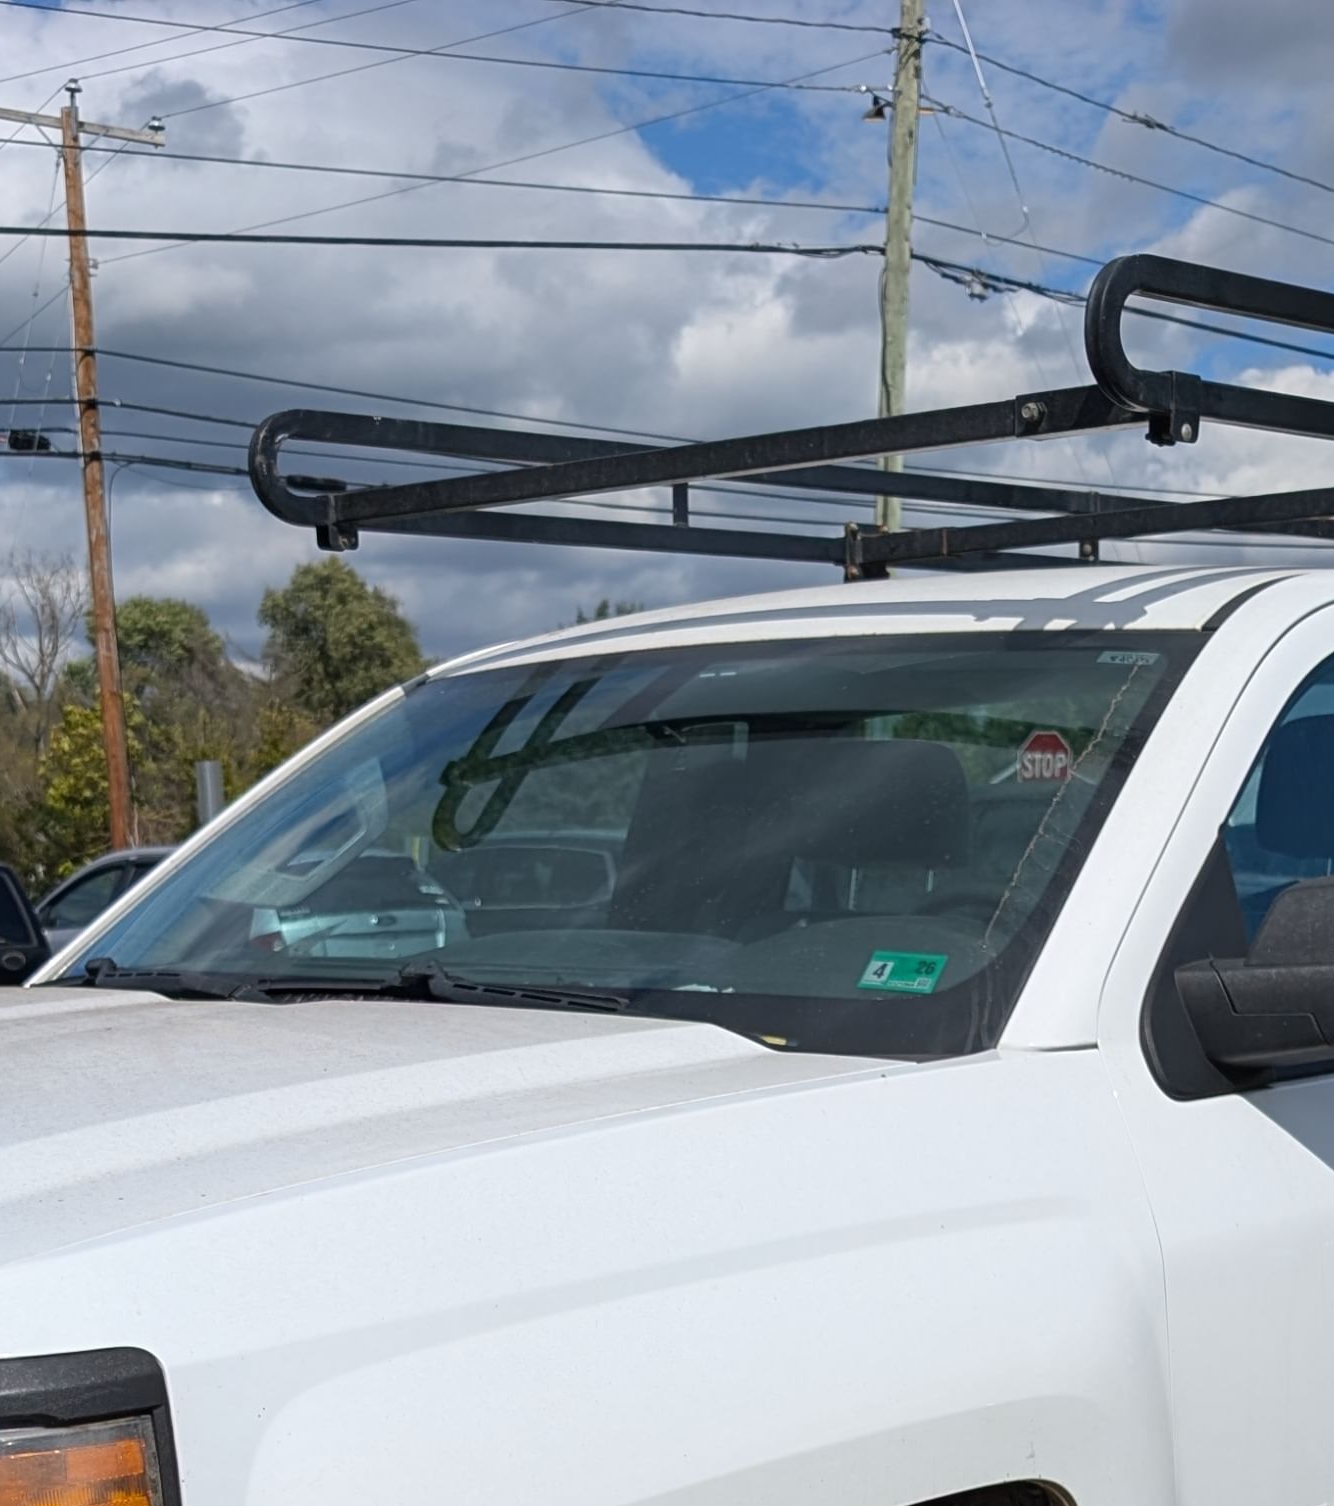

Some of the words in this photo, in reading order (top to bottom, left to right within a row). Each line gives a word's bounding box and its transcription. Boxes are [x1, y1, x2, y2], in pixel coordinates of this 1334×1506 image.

[1021, 751, 1067, 779] STOP
[872, 963, 888, 979] 4
[914, 960, 937, 975] 26
